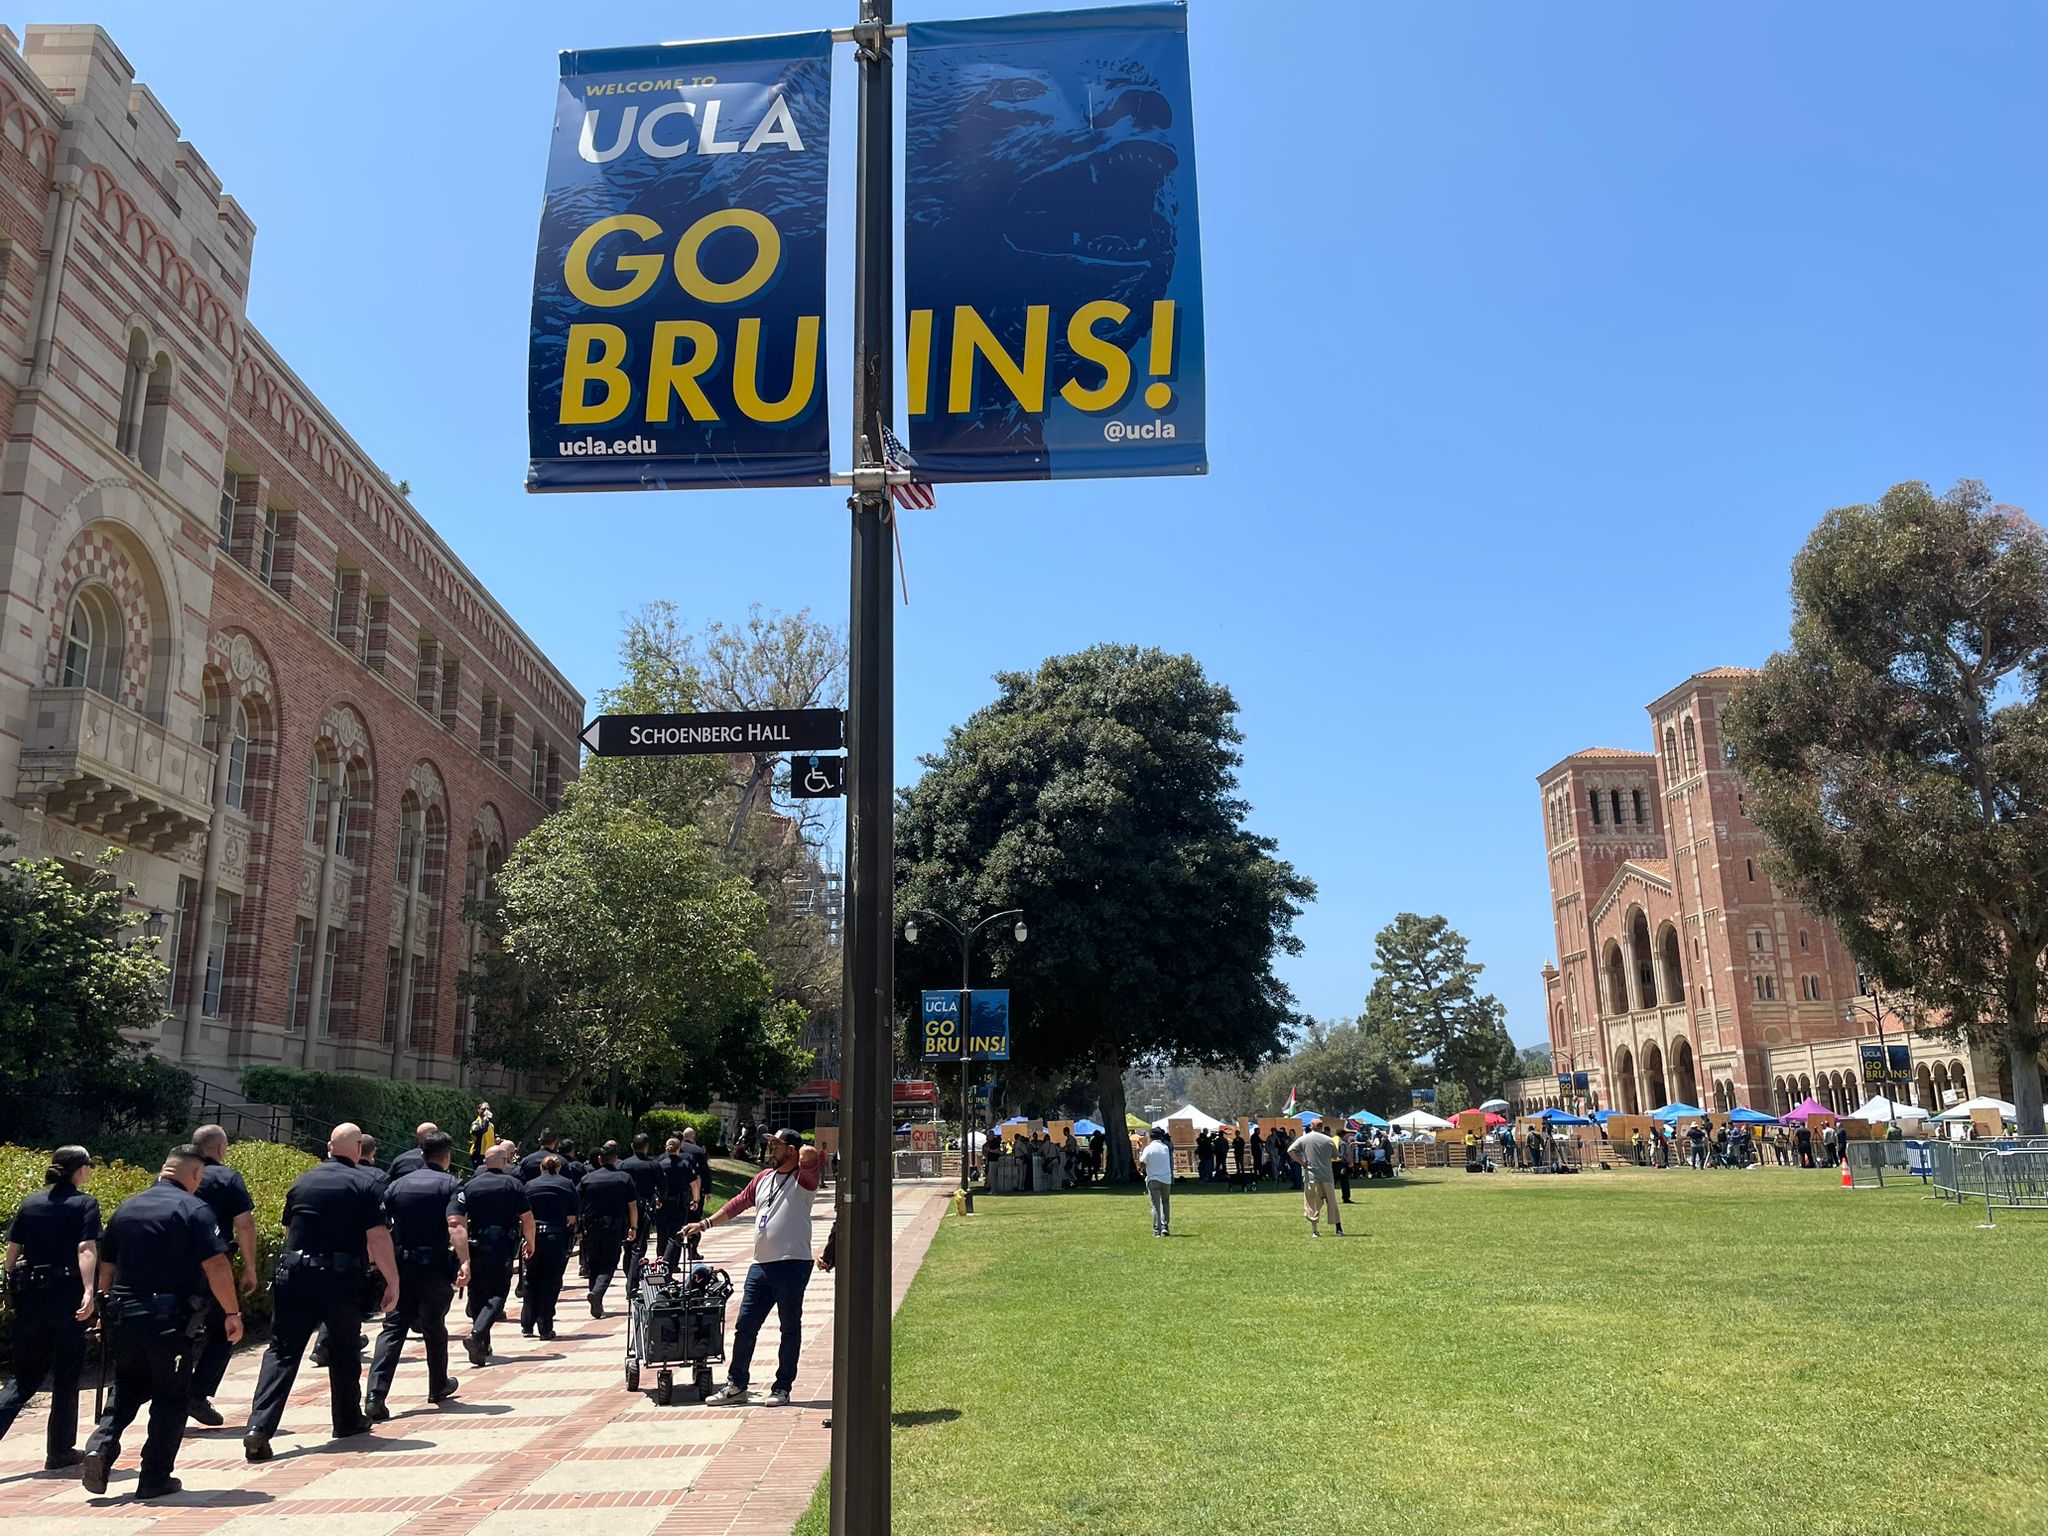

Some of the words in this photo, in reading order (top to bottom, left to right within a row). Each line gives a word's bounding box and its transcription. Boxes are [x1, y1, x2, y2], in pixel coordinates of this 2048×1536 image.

[586, 79, 684, 96] WELCOME
[691, 76, 718, 88] TO
[577, 94, 805, 164] UCLA
[563, 208, 782, 307] GO
[559, 315, 820, 424] BRU
[1104, 419, 1176, 442] @ucla
[559, 435, 657, 456] ucla.edu
[629, 726, 743, 745] SCHOENBERG
[748, 724, 790, 741] HALL
[925, 1001, 958, 1012] UCLA
[925, 1020, 955, 1036] GO
[1865, 1061, 1881, 1069] GO
